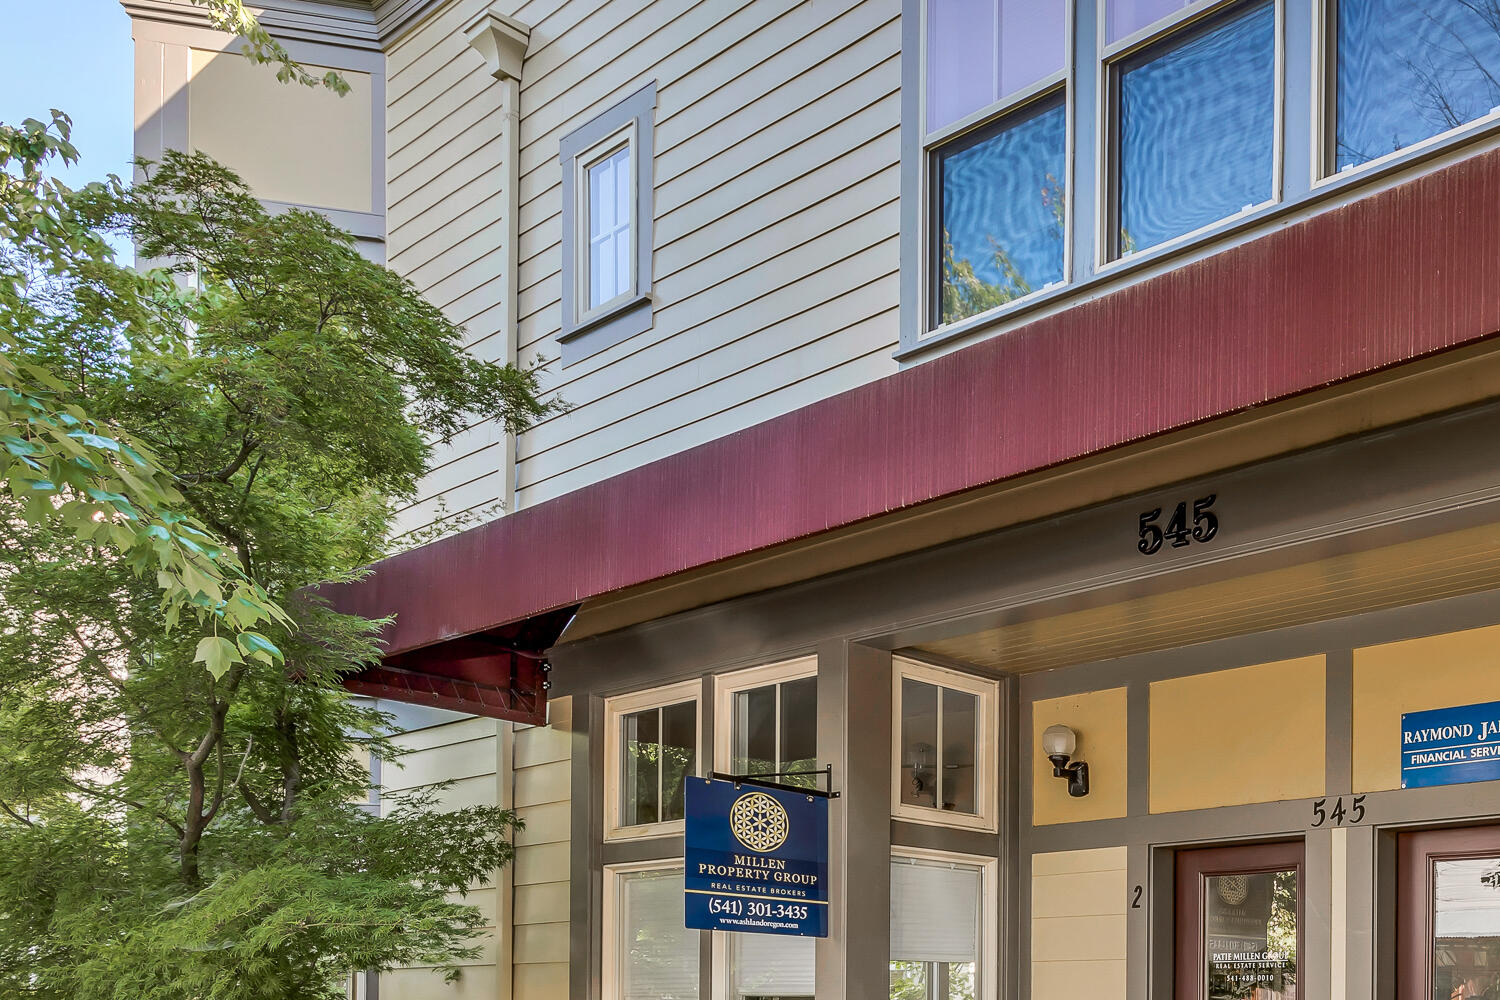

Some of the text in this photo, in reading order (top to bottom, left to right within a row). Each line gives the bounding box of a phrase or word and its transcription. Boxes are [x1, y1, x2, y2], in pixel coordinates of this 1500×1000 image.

[1138, 494, 1219, 555] 545
[1403, 723, 1474, 745] RAYMOND
[1411, 750, 1467, 765] FINANCIAL
[1311, 795, 1367, 827] 545
[734, 854, 786, 870] MILLEN
[698, 863, 818, 886] PROPERTY GROUP
[711, 882, 806, 897] REAL ESTATE BROKERS
[1131, 885, 1143, 909] 2
[708, 897, 808, 920] (541) 301-3435
[719, 918, 799, 929] www.ashlandoregon.com
[1213, 952, 1232, 961] PATIE
[1233, 952, 1260, 960] MILLEN
[1226, 974, 1274, 982] 541-488-0010
